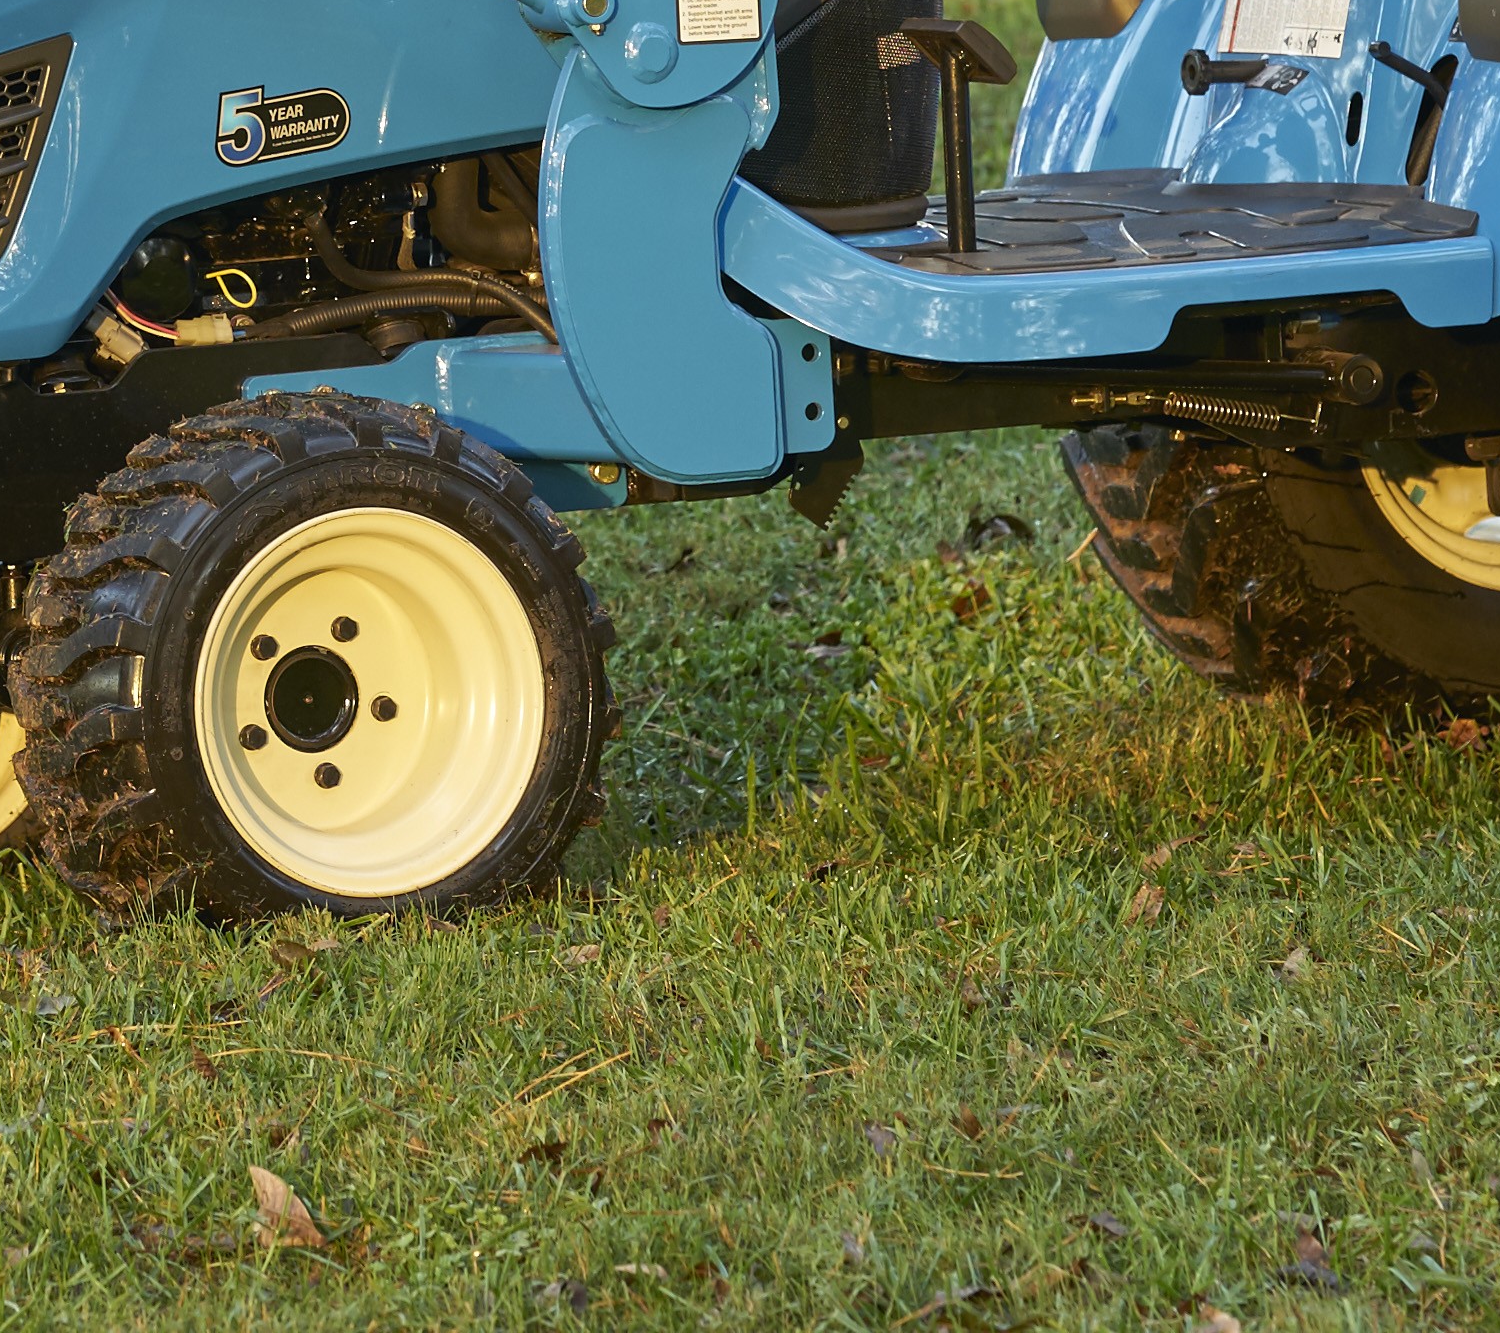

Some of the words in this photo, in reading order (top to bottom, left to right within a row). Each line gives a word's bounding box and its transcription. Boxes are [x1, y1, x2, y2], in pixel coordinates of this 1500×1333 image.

[217, 87, 266, 165] 5
[269, 104, 304, 122] YEAR
[270, 114, 340, 140] WARRANTY
